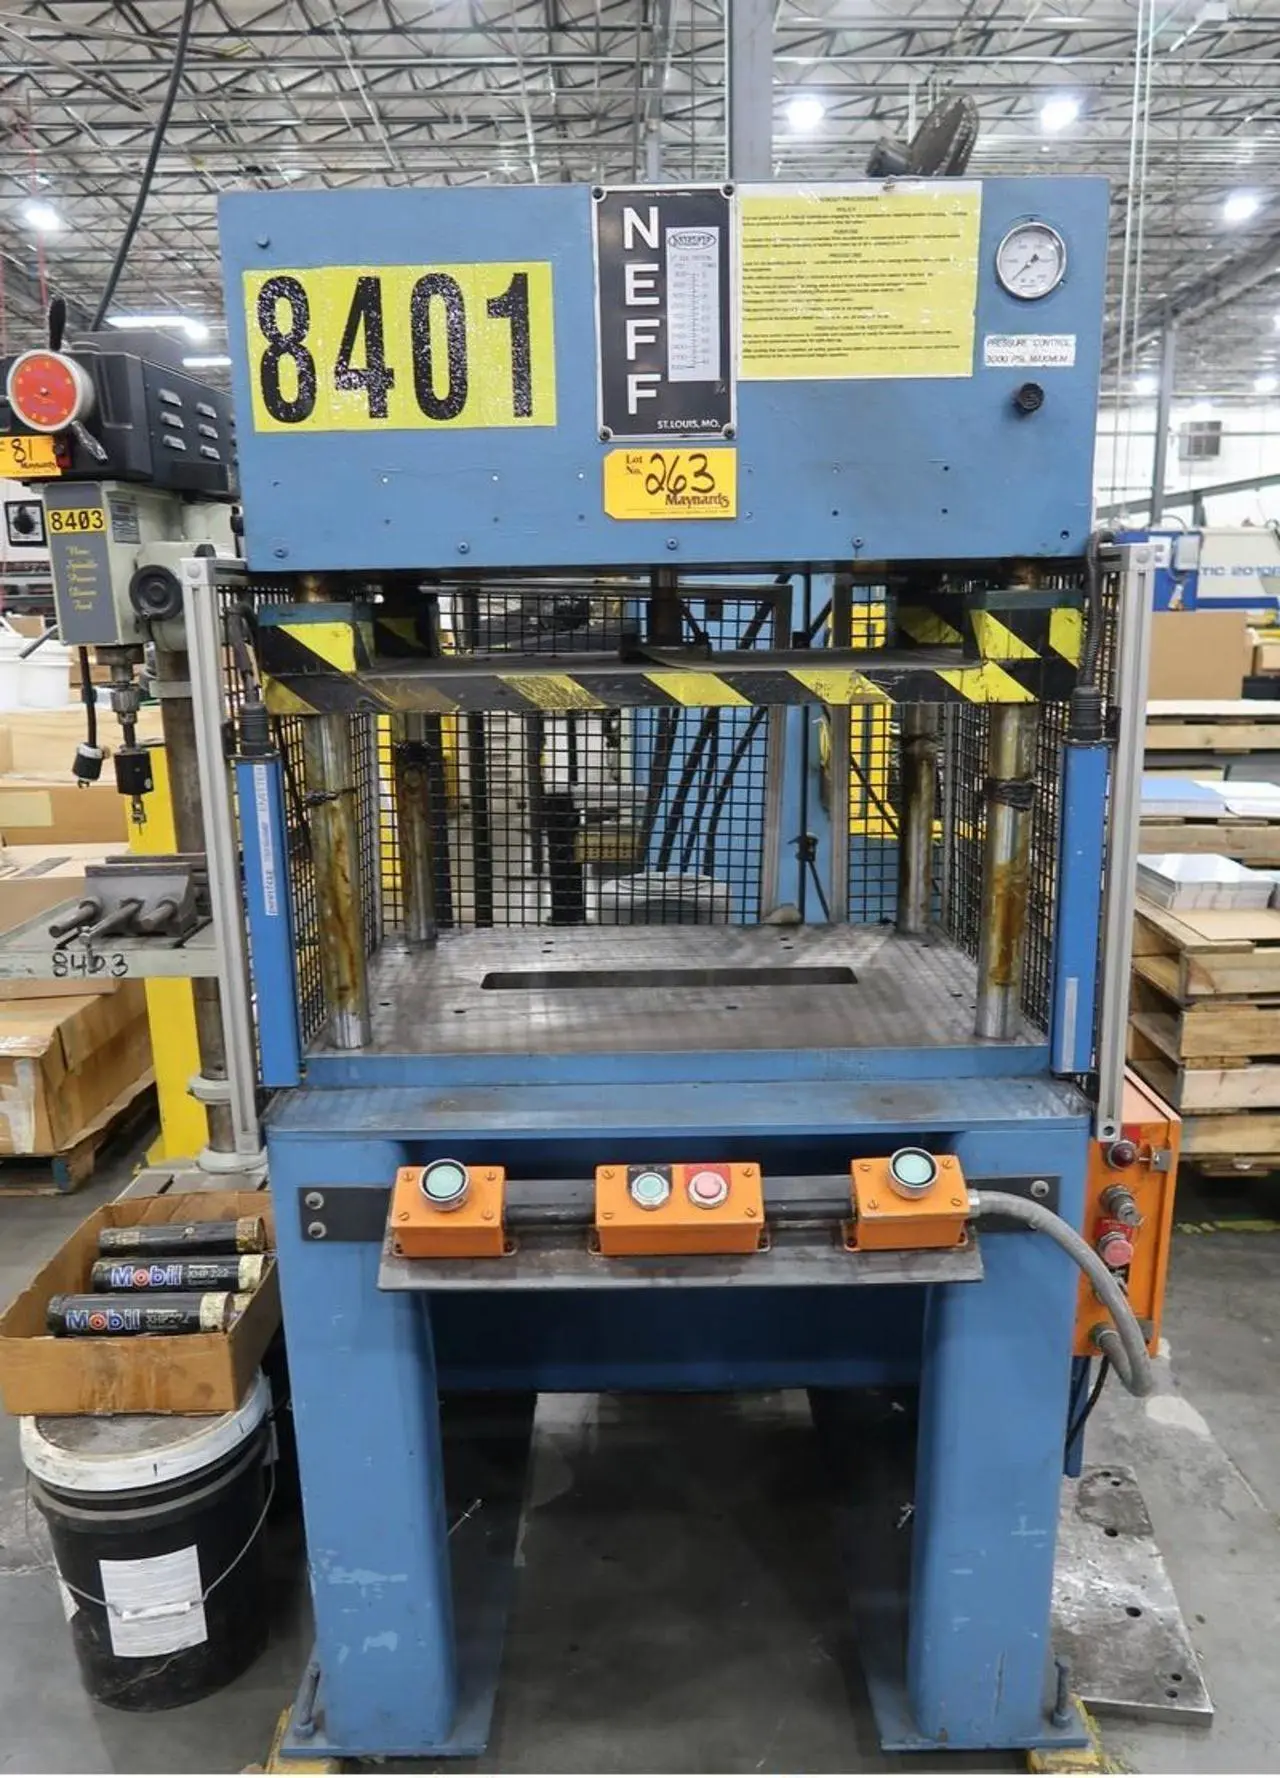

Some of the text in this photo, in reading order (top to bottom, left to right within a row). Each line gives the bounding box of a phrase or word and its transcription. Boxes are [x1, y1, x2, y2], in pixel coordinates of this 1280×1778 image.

[623, 206, 662, 415] NEFF
[257, 272, 533, 423] 8401
[645, 452, 716, 496] 263
[665, 493, 730, 509] Maynards
[50, 510, 103, 531] 8403
[52, 952, 129, 977] 8403
[111, 1264, 183, 1288] Mobil
[65, 1308, 141, 1331] Mobil
